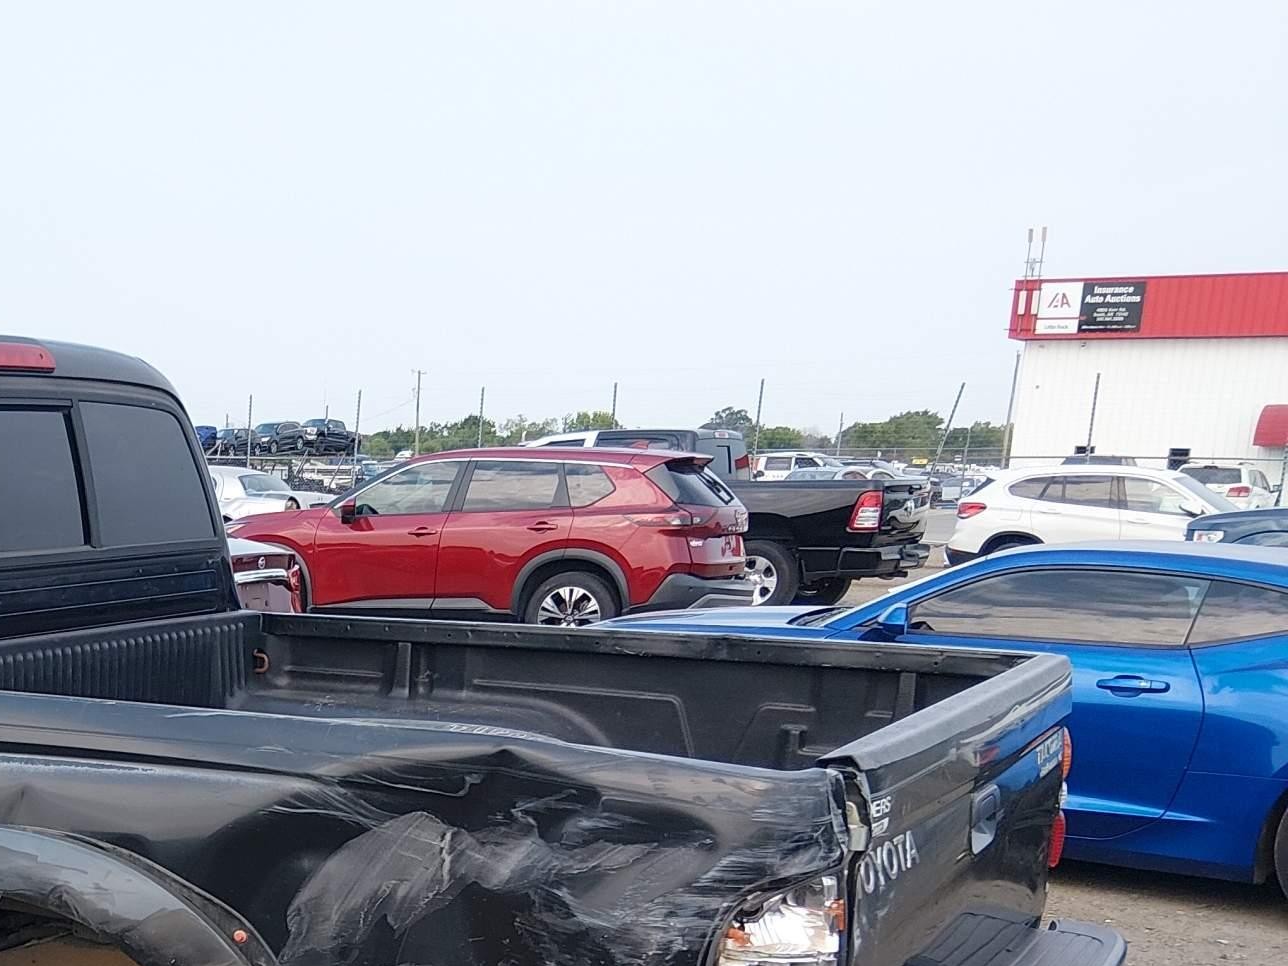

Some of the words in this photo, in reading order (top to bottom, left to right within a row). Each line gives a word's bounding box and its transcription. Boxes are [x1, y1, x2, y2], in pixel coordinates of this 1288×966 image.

[1094, 286, 1134, 294] Insurance
[1084, 294, 1104, 303] Auto
[1104, 294, 1141, 303] Auctions
[859, 829, 921, 894] OYOTA
